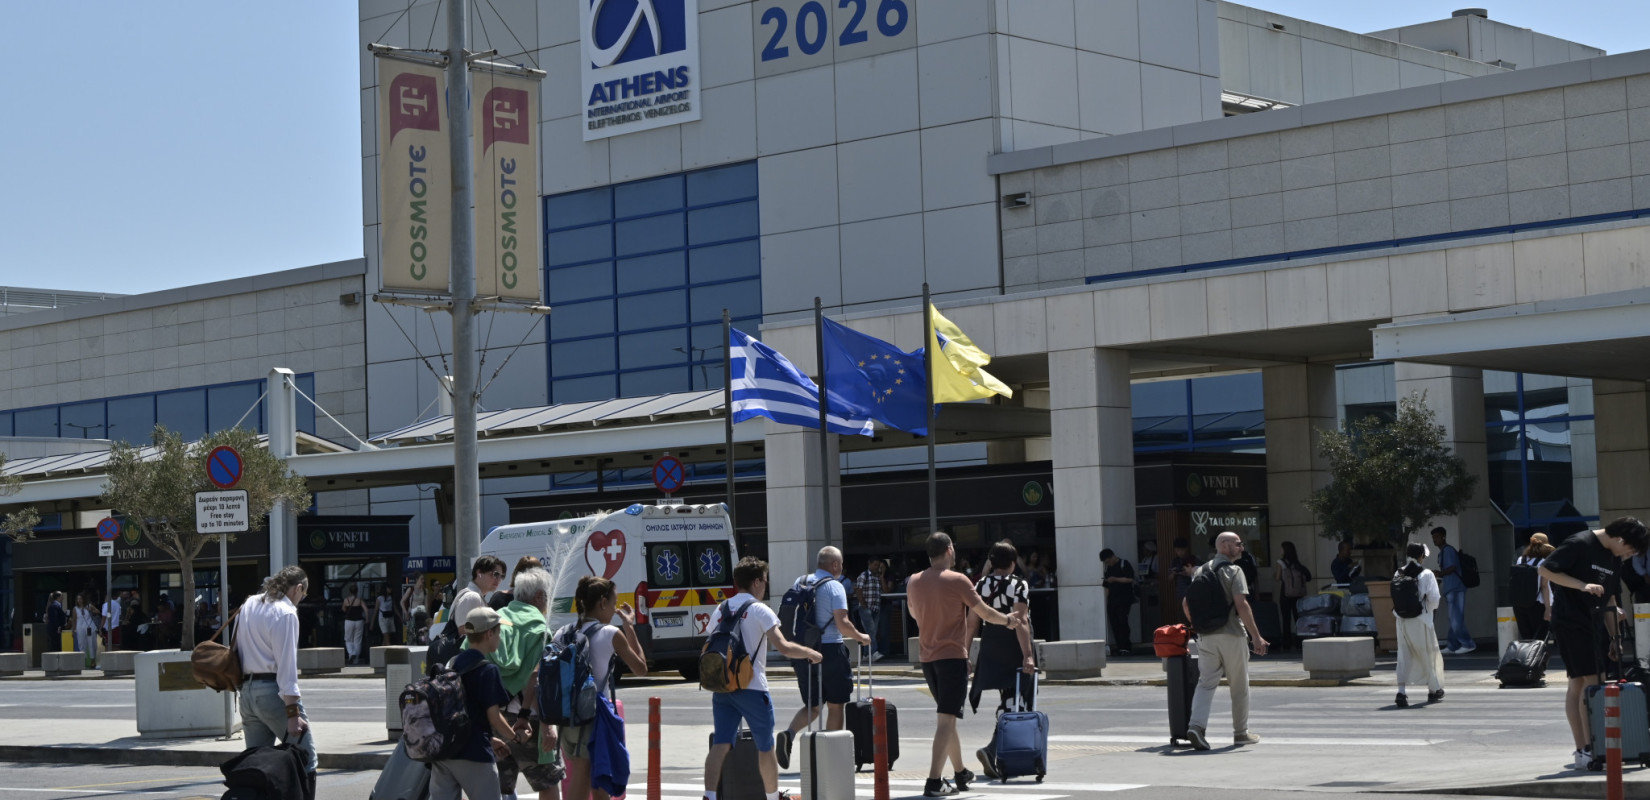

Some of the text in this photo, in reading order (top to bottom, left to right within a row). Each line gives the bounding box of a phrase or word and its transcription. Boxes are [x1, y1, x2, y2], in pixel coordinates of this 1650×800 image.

[760, 0, 909, 62] 2026
[587, 66, 690, 106] ATHENS
[588, 90, 690, 118] INTERNATIONAL AIRPORT
[588, 102, 691, 130] ELEFTHERIOS VENIZELOS
[409, 144, 428, 281] COSMOTE
[500, 157, 518, 290] COSMOTE
[1202, 475, 1239, 488] VENETI
[646, 523, 669, 532] ΟΜΙΛΟΣ
[670, 523, 696, 531] ΙΑΤΡΙΚΟΥ
[1209, 517, 1236, 526] TAILOR
[328, 531, 369, 542] VENETI
[117, 548, 146, 559] VENETI
[407, 559, 423, 568] ATM
[432, 558, 451, 567] ATM
